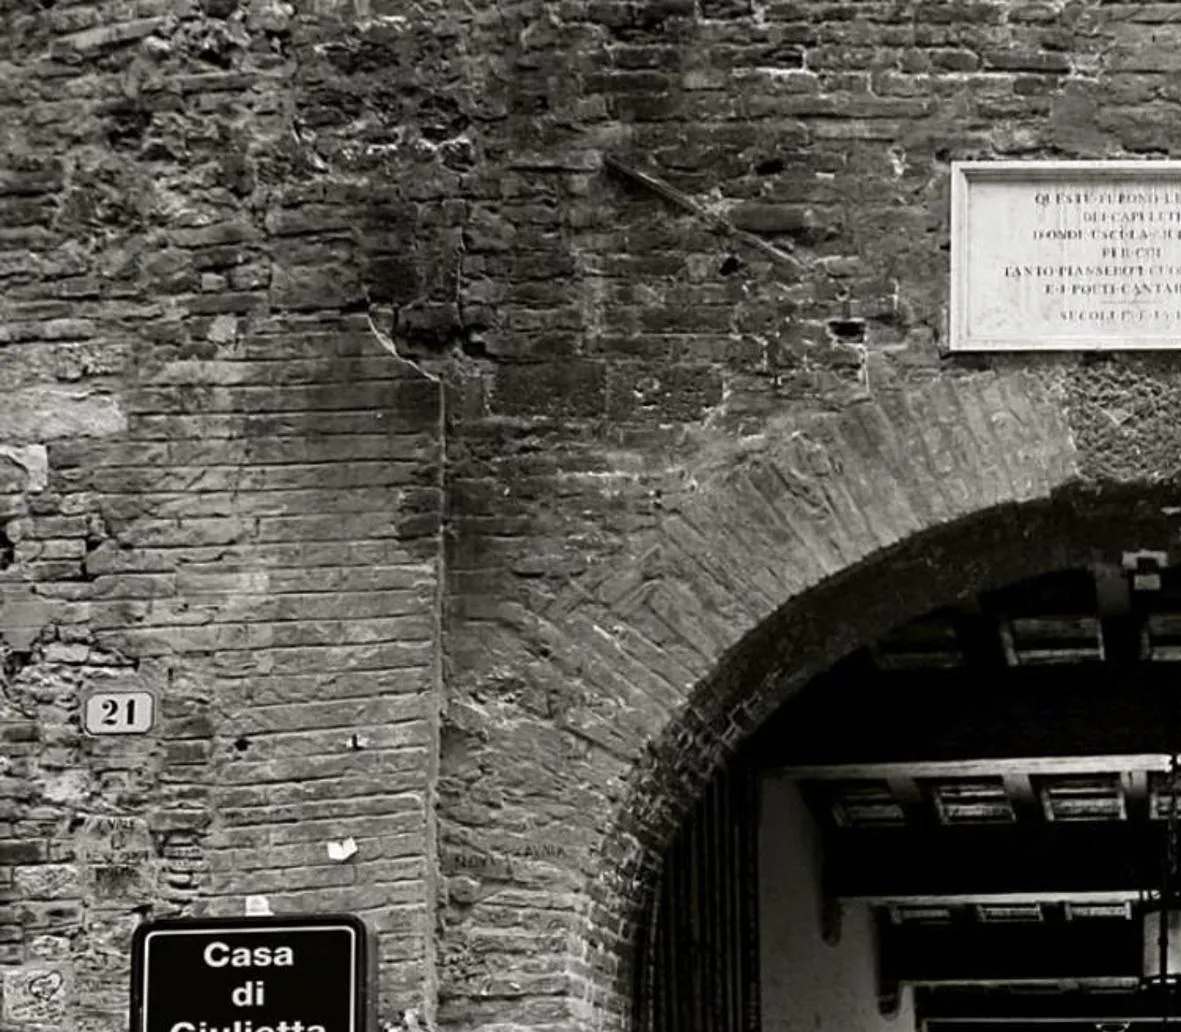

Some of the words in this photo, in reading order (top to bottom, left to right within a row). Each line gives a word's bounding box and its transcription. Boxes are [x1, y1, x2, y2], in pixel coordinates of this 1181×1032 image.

[101, 699, 136, 726] 21
[203, 941, 294, 968] Casa
[231, 980, 265, 1007] di
